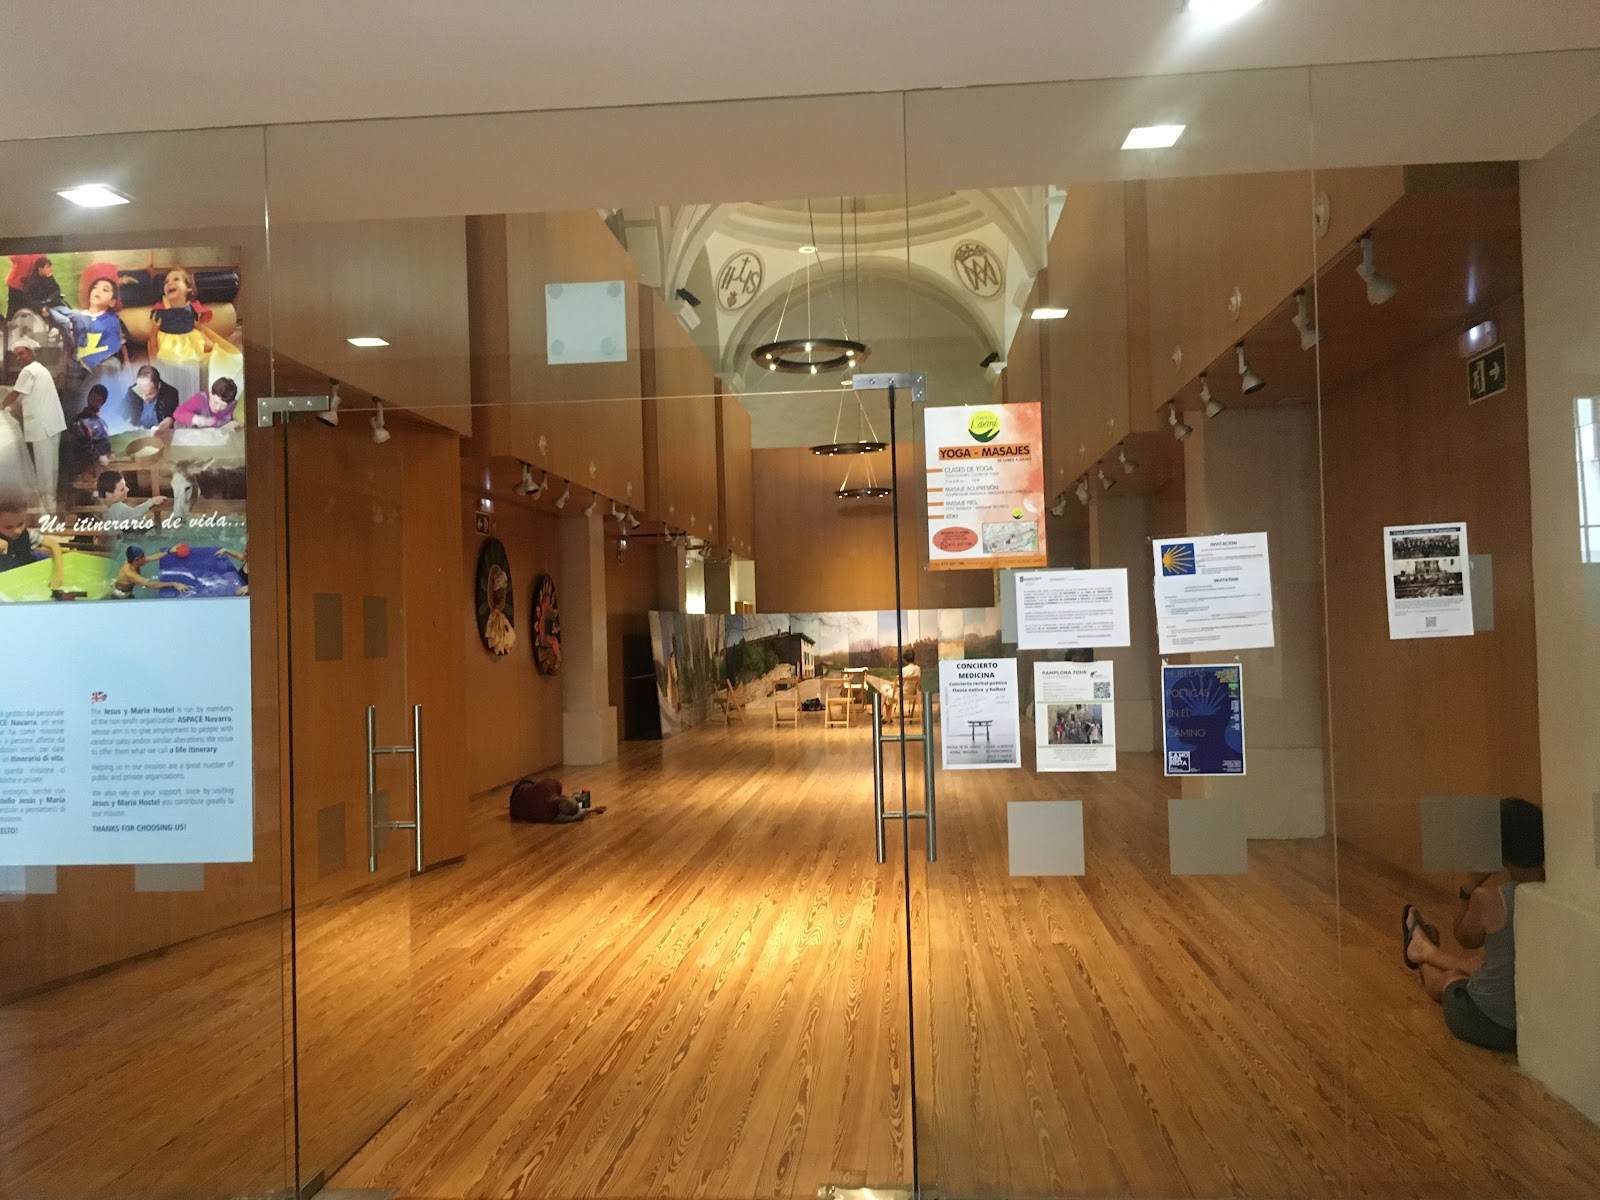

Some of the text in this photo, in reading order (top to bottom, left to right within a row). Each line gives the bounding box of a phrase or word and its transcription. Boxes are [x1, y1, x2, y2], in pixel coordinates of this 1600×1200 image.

[940, 448, 971, 459] YOGA
[981, 445, 1030, 457] MASAJES
[38, 510, 246, 533] Un itinerario de vida...
[956, 662, 998, 670] CONCIERTO
[152, 727, 189, 735] employment
[198, 726, 219, 735] people
[1167, 729, 1206, 737] CAMINO
[188, 746, 218, 755] itinerary
[136, 824, 173, 832] CHOOSING
